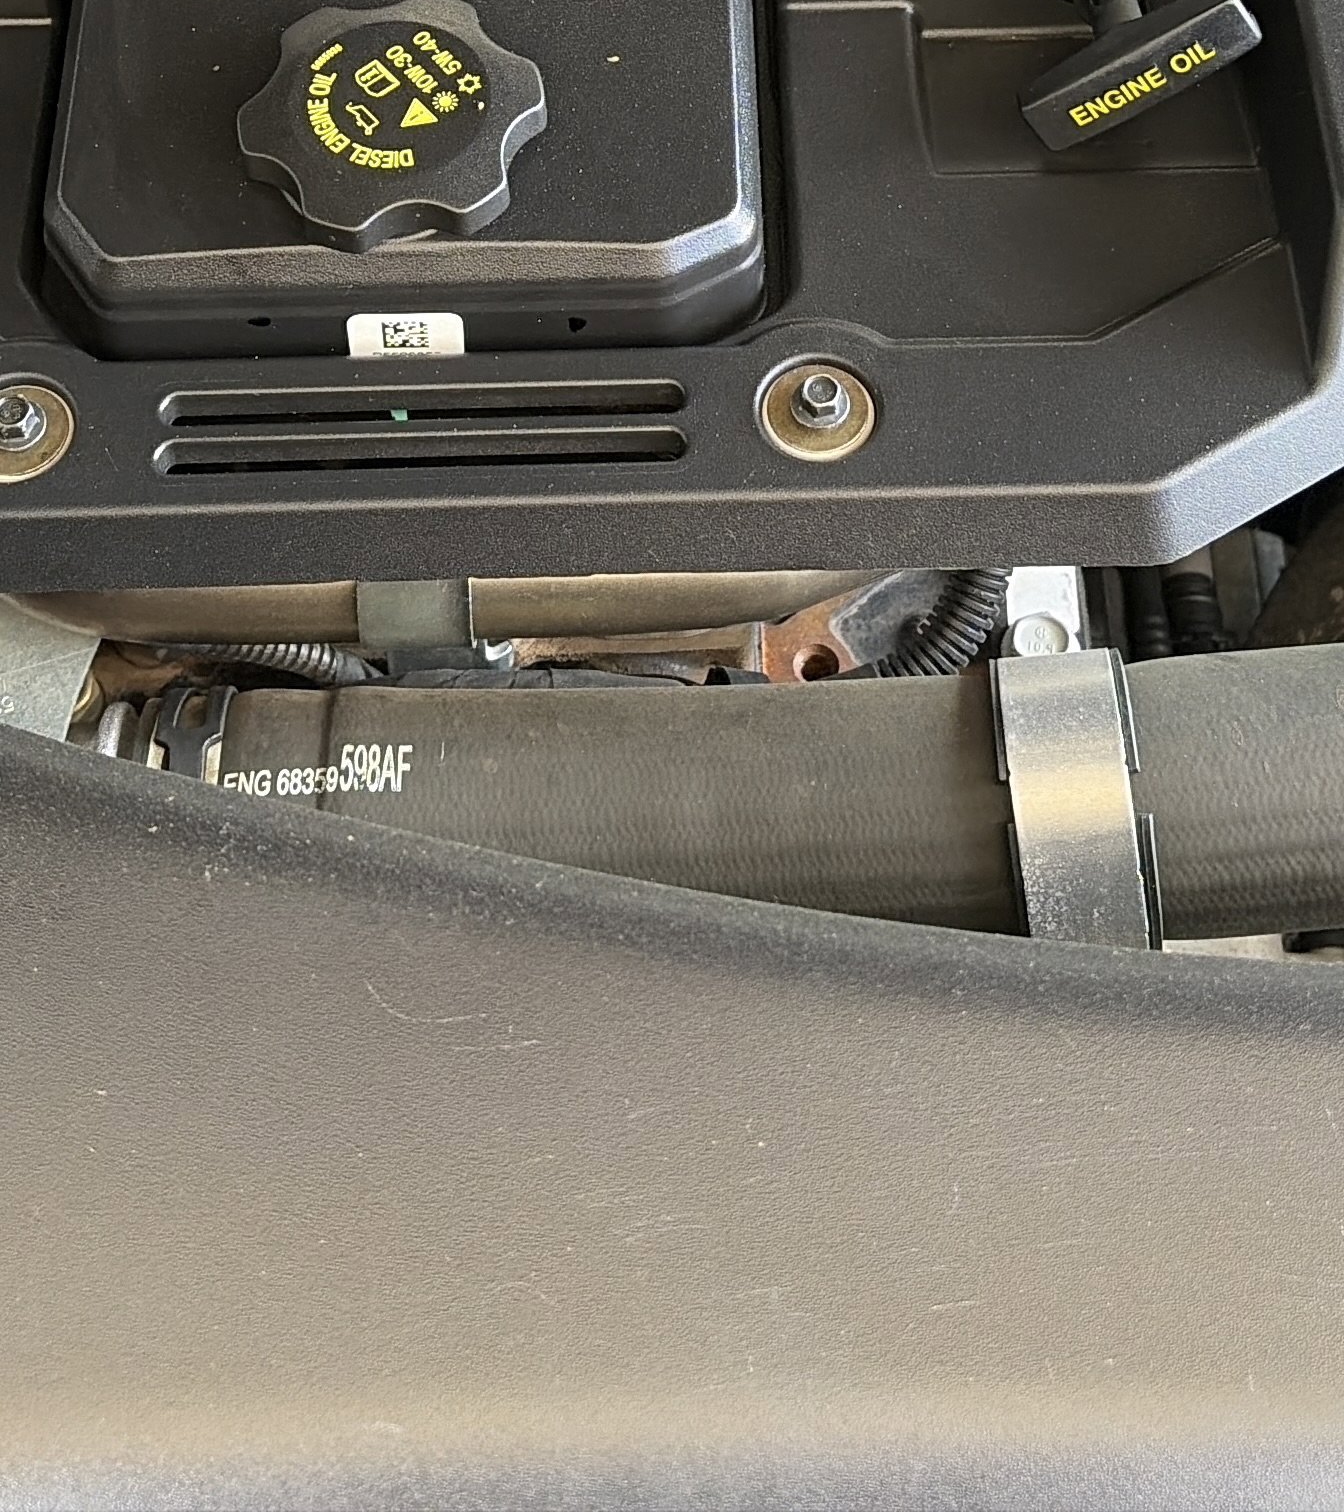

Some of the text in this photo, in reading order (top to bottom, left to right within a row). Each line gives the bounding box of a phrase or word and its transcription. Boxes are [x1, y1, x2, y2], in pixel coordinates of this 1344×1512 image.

[385, 45, 438, 93] 10W-30
[413, 31, 462, 75] 5W-40
[308, 72, 338, 96] OIL
[1069, 40, 1217, 127] ENGINE OIL
[307, 97, 351, 154] ENGINE
[348, 141, 415, 169] DIESEL
[276, 744, 413, 796] 68359598AF
